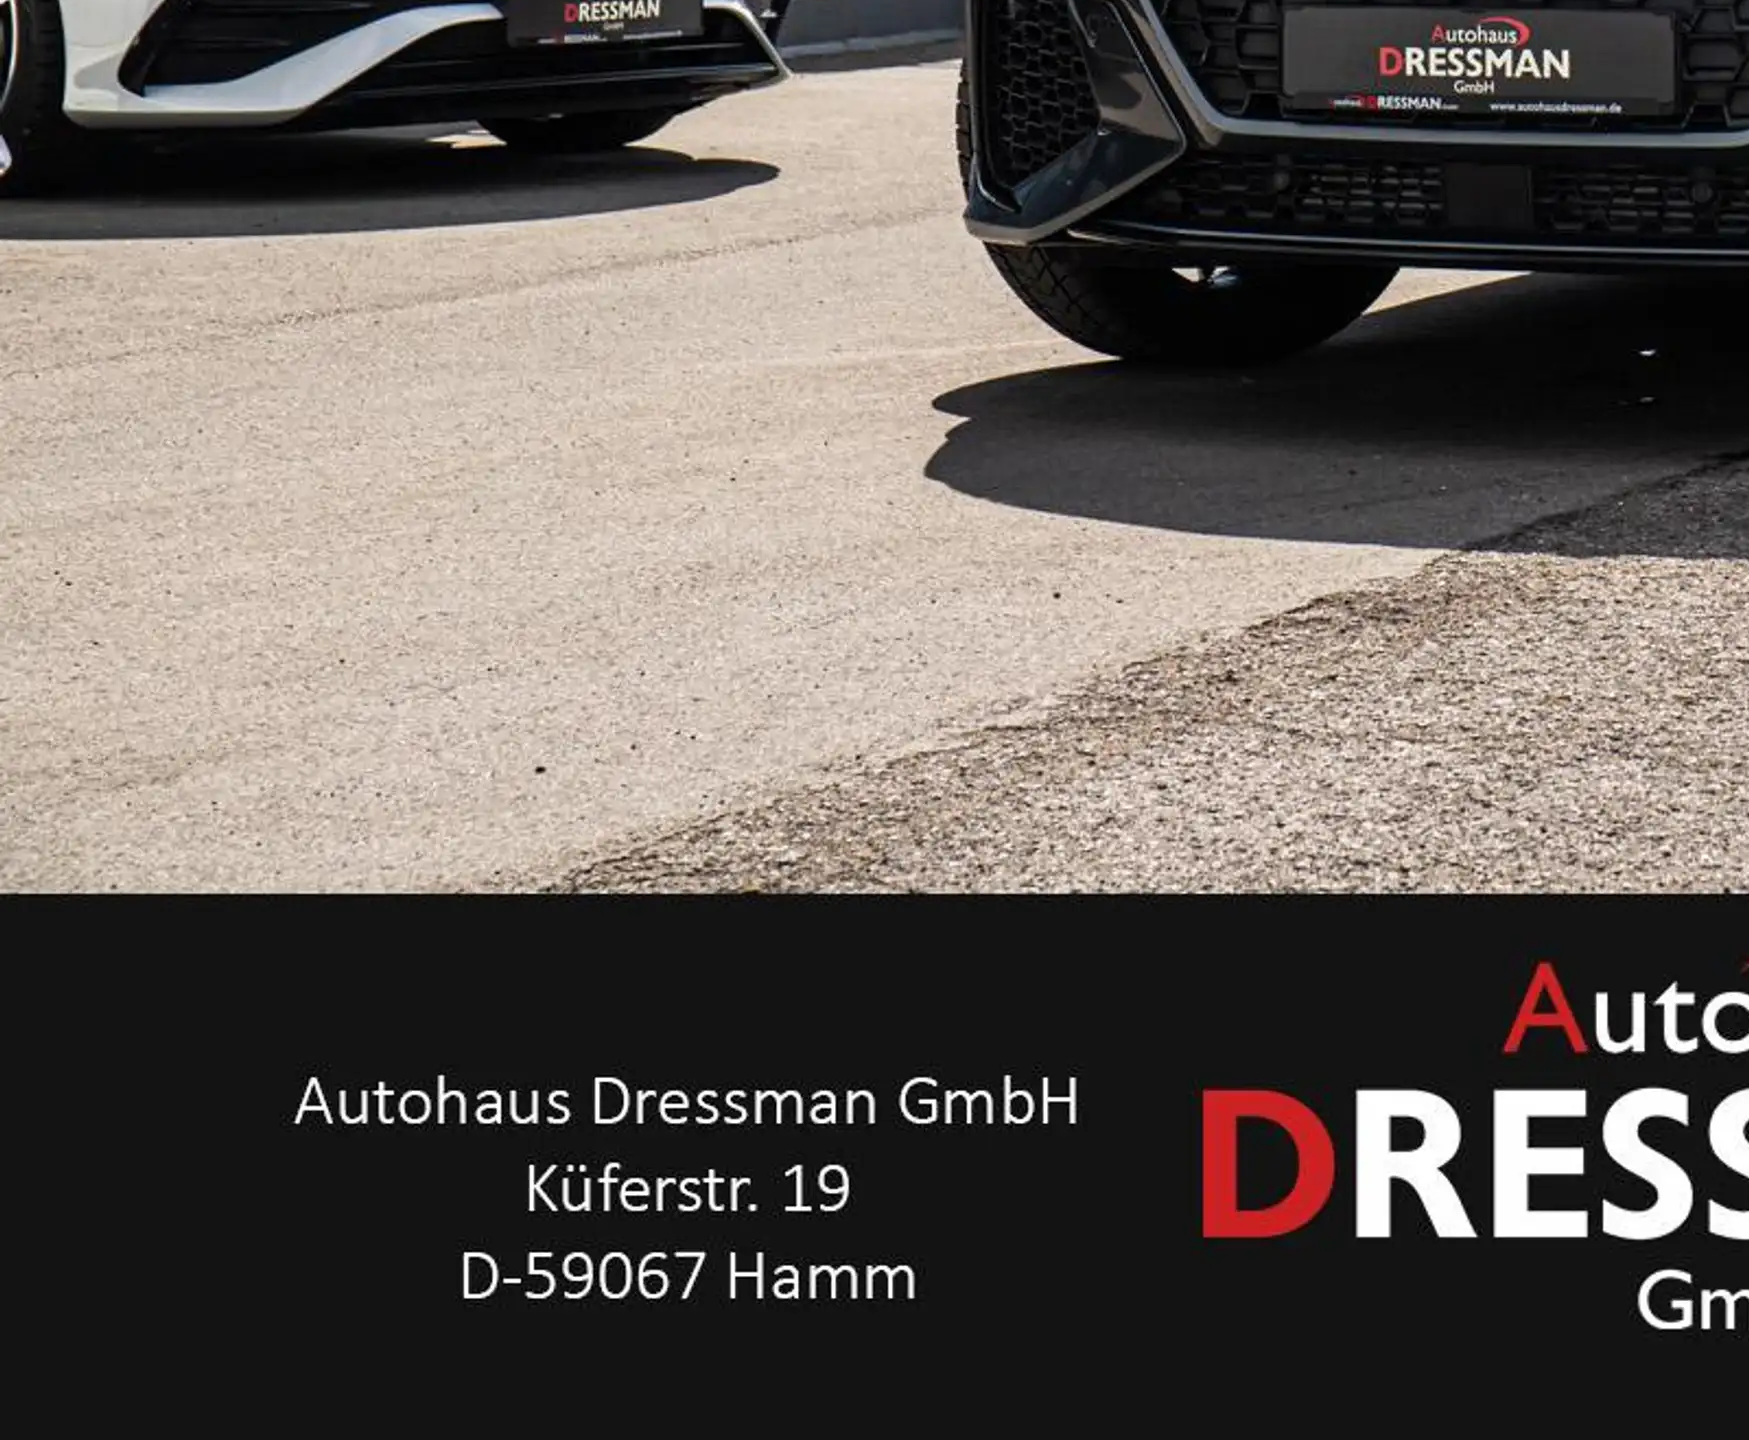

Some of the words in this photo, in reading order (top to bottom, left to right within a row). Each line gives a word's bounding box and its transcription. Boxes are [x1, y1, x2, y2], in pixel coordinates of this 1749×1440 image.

[1431, 24, 1518, 45] Autohaus
[1378, 46, 1571, 79] DRESSMAN
[1453, 80, 1495, 95] GmbH
